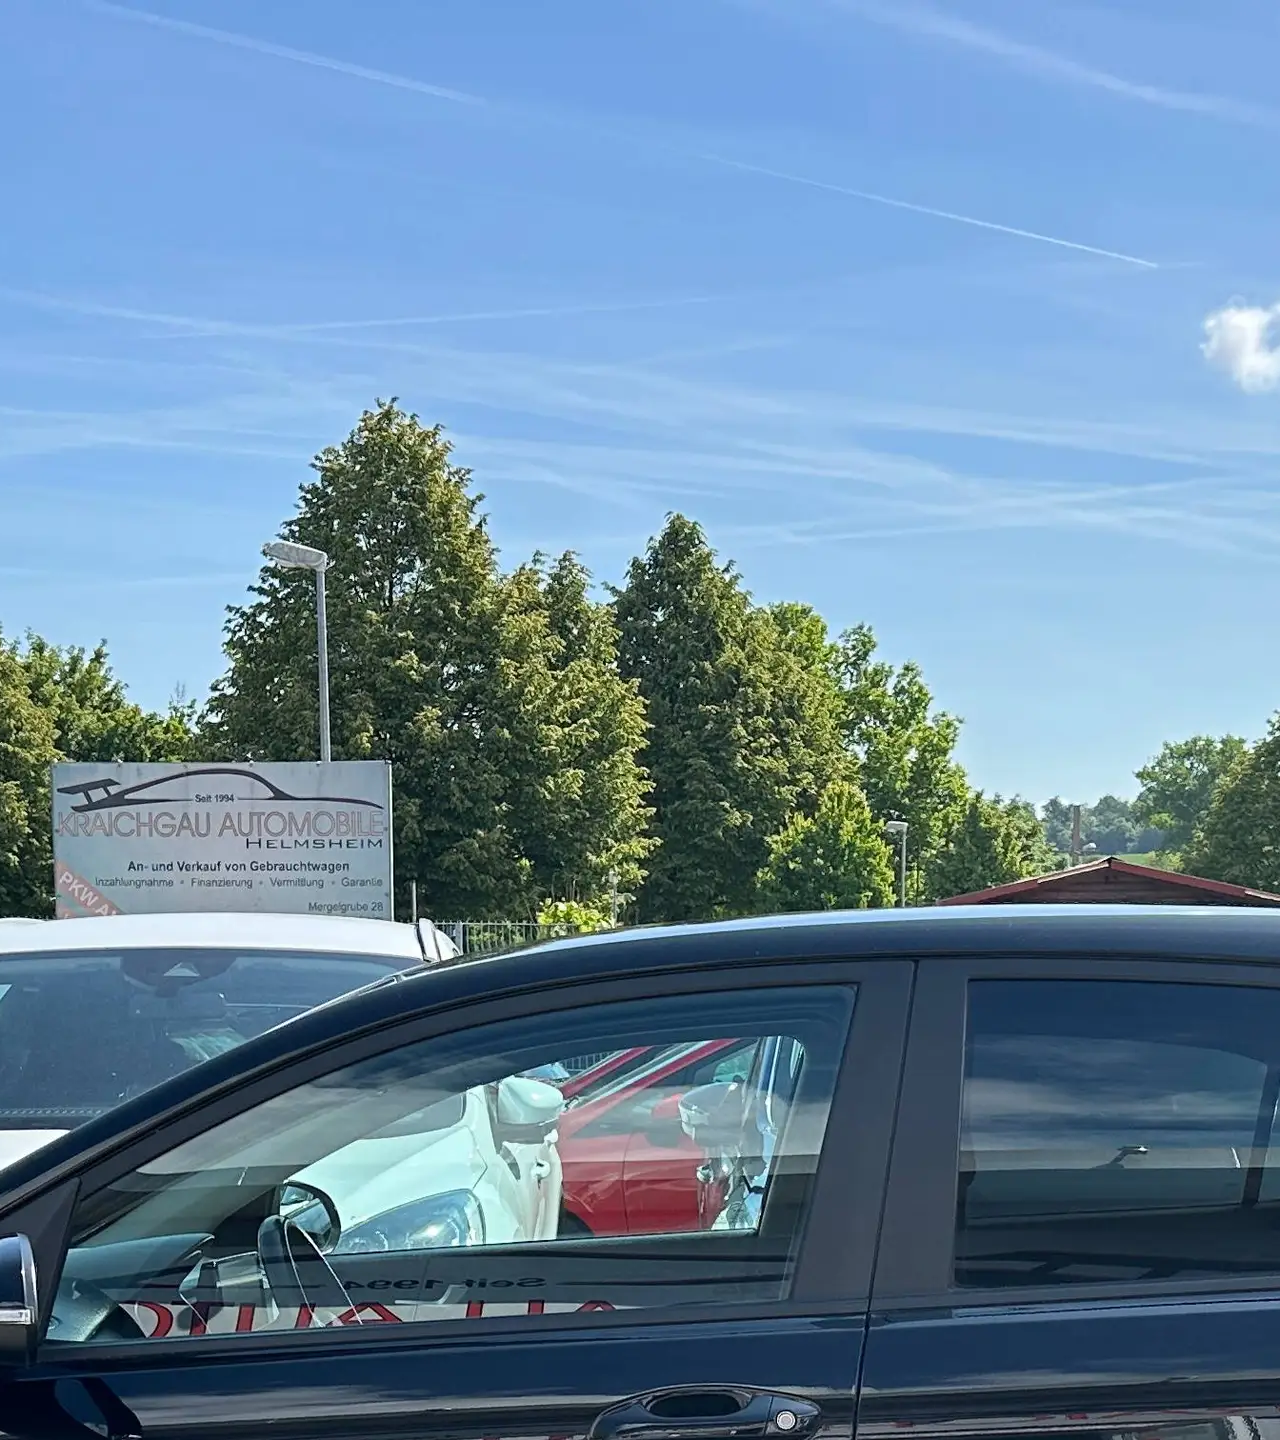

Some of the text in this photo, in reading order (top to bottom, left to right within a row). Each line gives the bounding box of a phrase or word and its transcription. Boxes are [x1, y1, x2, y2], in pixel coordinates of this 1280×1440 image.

[195, 794, 235, 803] Seit 1994
[58, 811, 384, 838] KRAICHGAU AUTOMOBILE
[246, 838, 383, 849] HELMSHEIM
[128, 861, 350, 873] An- und Verkauf von Gebrauchtwagen
[95, 877, 383, 888] Inzahlungnahme Finanzierung Vermittlung Garantie
[60, 872, 99, 907] PKW
[308, 902, 384, 914] Mergelgrube 28
